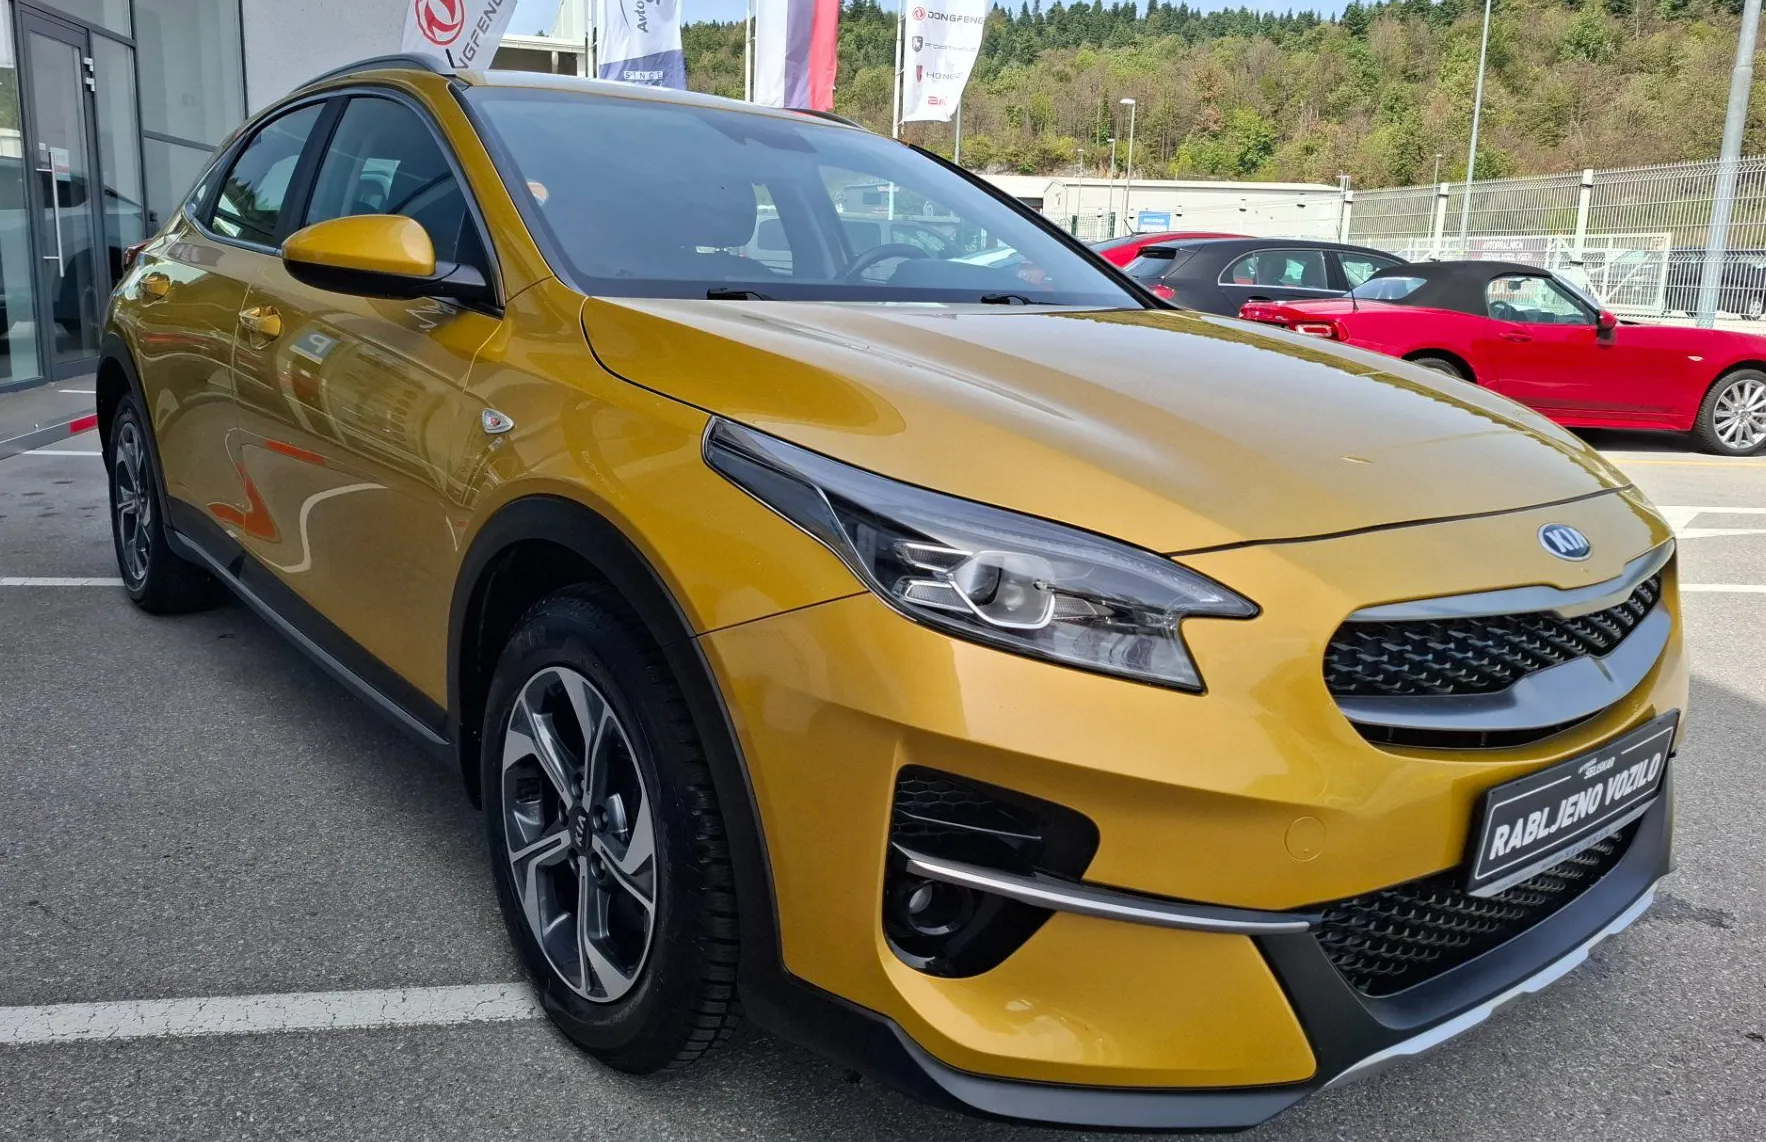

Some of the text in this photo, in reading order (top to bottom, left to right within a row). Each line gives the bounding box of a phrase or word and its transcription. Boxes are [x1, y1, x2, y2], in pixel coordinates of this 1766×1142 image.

[927, 11, 984, 24] DONGFENG
[625, 71, 663, 79] SINCE
[1545, 528, 1590, 553] KIA
[1489, 752, 1661, 860] RABLJENO VOZILO
[575, 816, 586, 847] KIA
